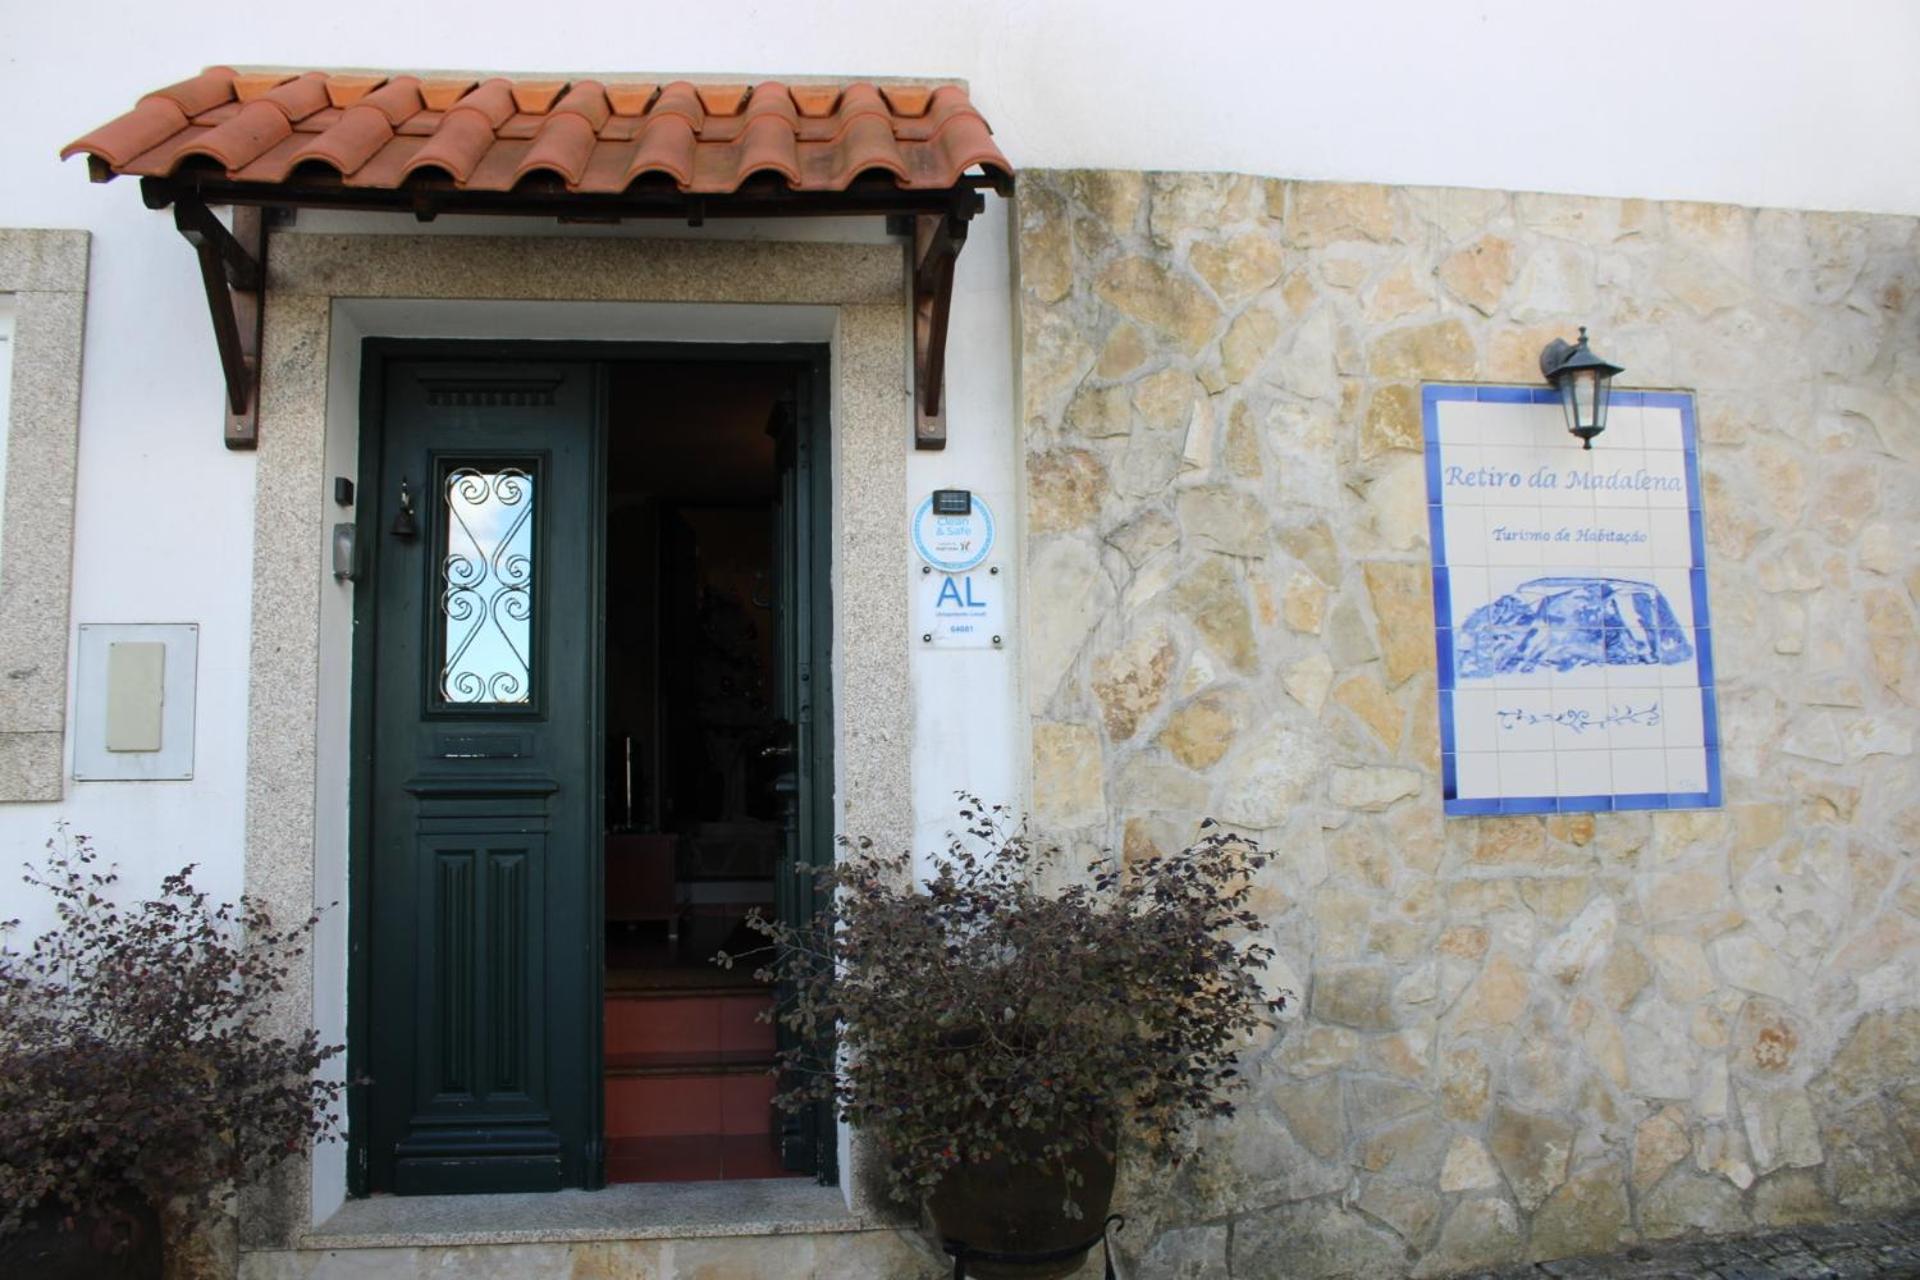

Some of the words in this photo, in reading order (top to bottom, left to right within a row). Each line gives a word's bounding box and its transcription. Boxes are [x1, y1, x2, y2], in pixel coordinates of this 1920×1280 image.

[1446, 465, 1521, 488] Retiro
[1528, 466, 1557, 489] da
[1565, 468, 1683, 492] Madalena
[1554, 527, 1570, 542] de
[936, 576, 986, 608] AL
